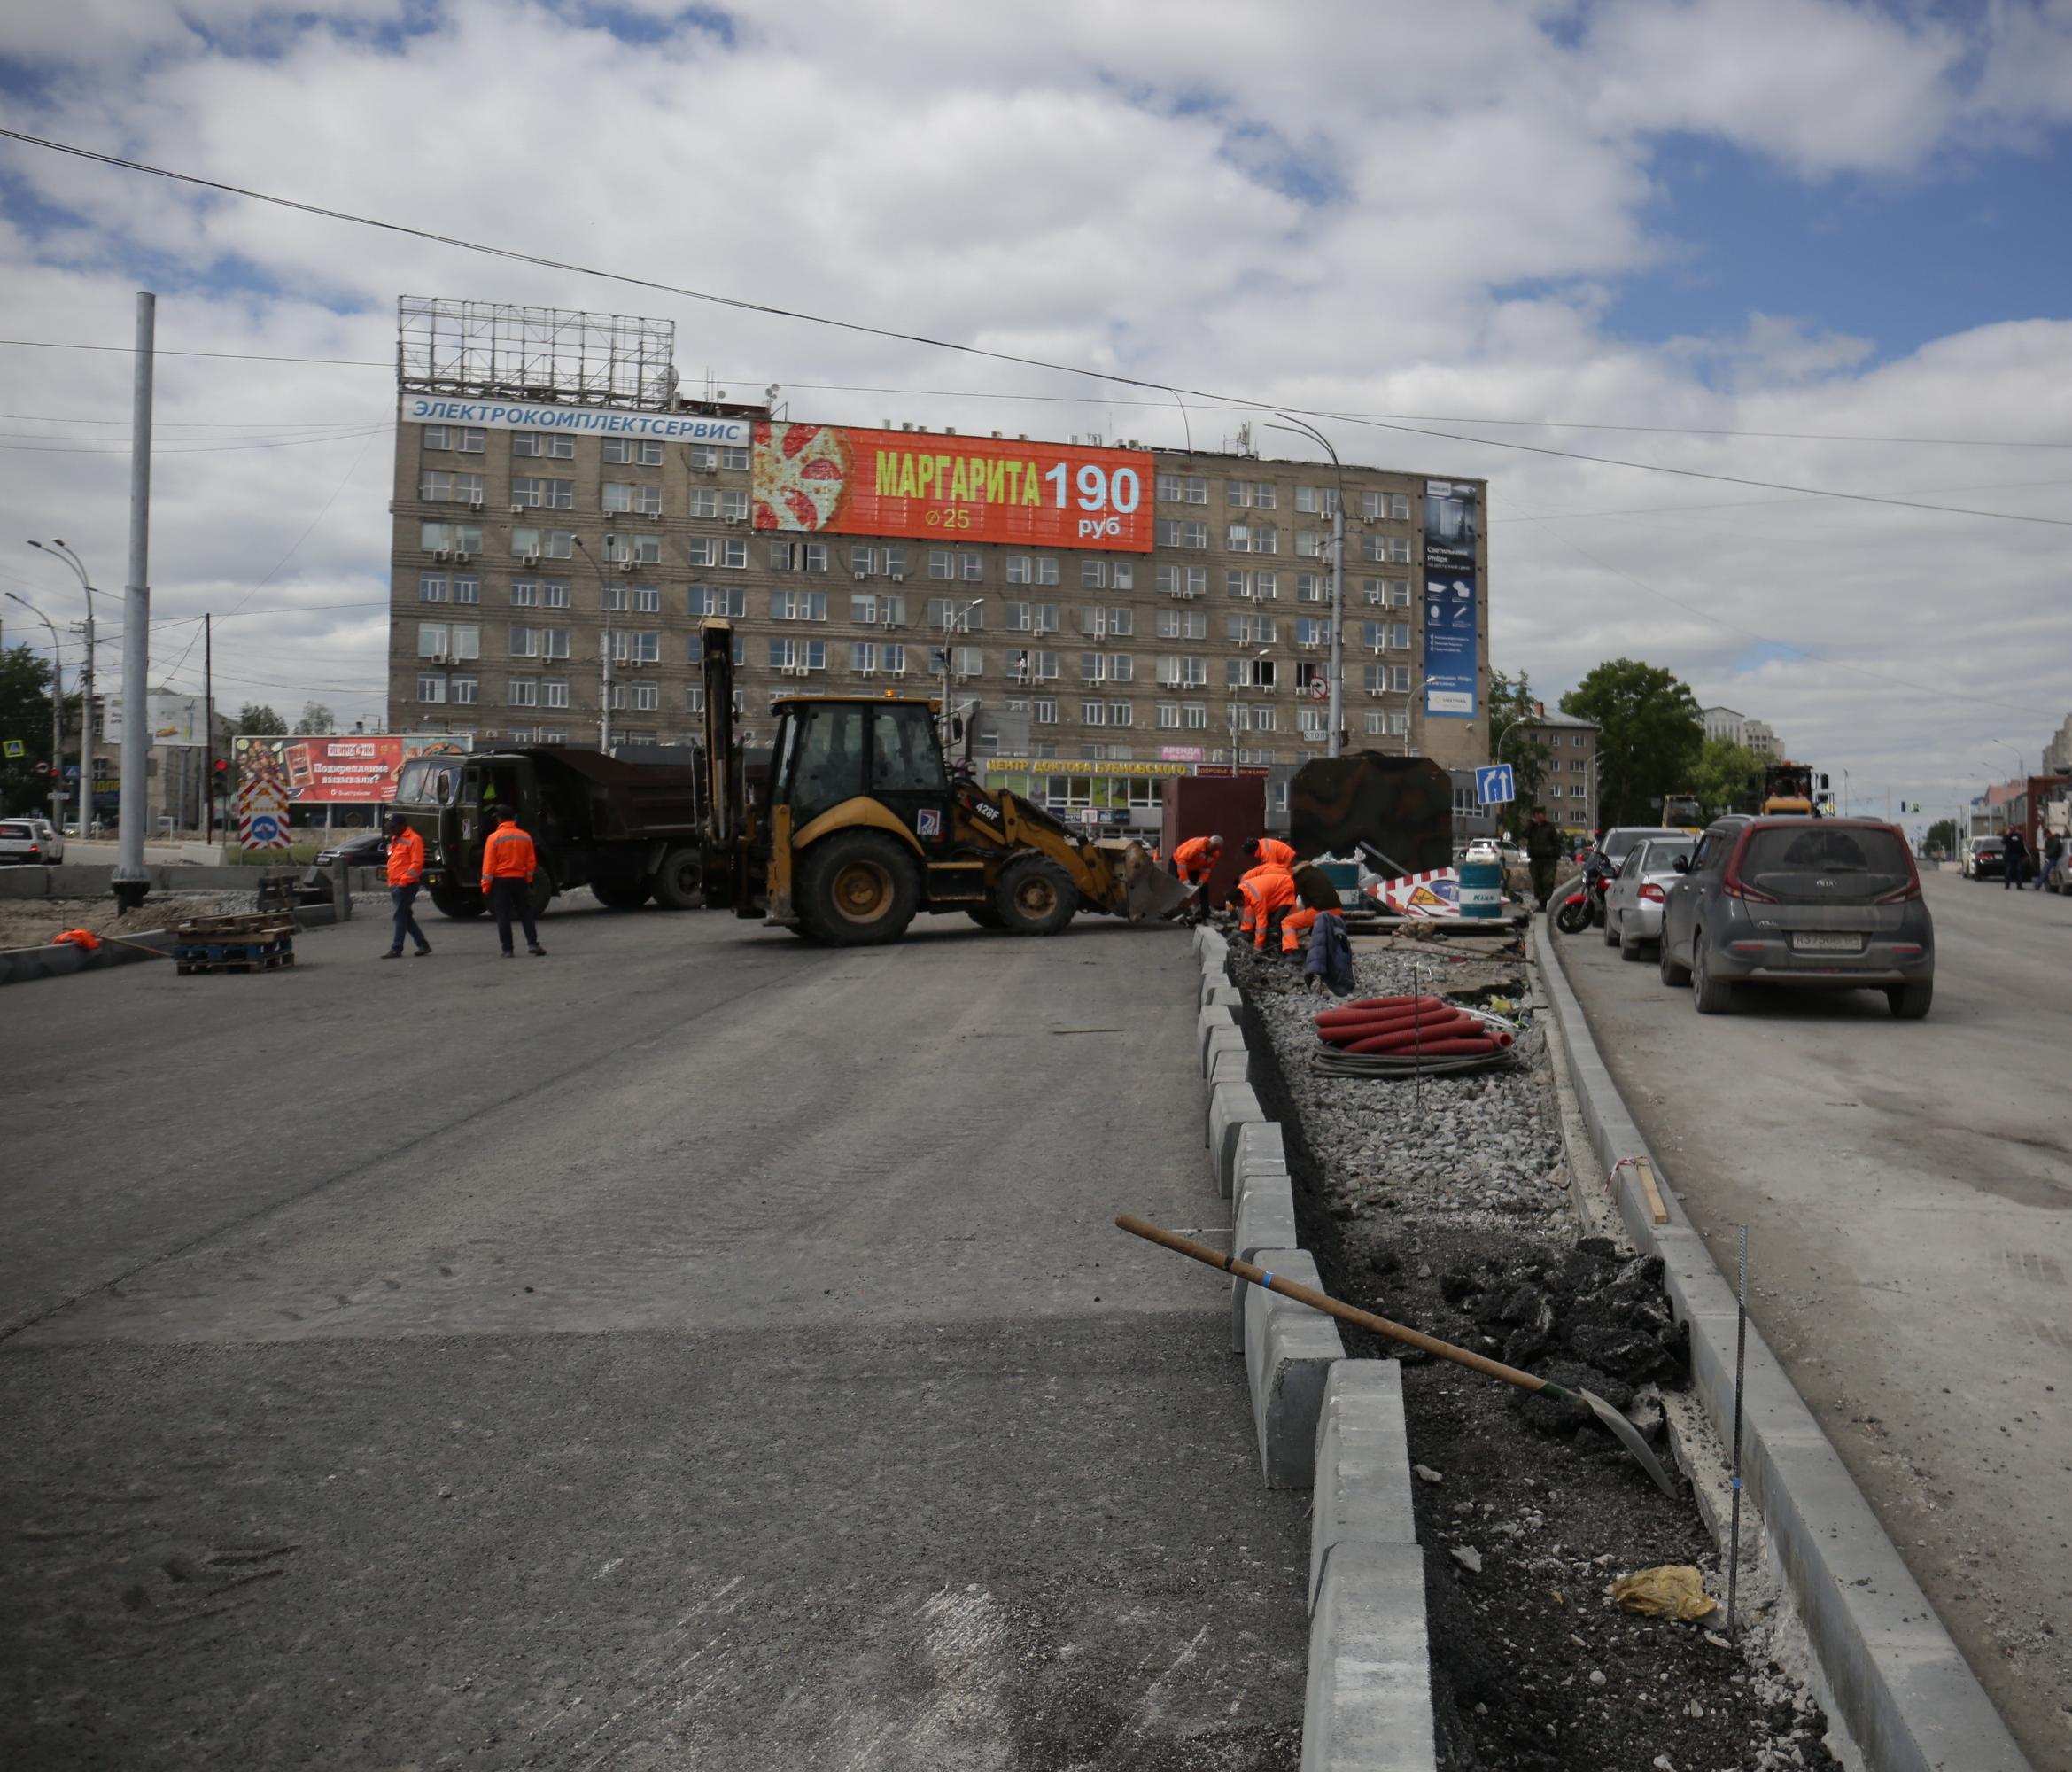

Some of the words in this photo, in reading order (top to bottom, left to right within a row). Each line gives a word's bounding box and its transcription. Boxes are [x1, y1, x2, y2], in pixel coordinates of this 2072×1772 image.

[412, 400, 741, 441] ЭЛЕКТРОКОМПЛЕКТСЕРВИС
[875, 450, 1042, 507] МАРГАРИТА
[1045, 462, 1141, 514] 190
[1078, 516, 1121, 538] руб
[986, 758, 1029, 773] ЦЕНТР
[1033, 760, 1092, 773] ДОКТОРА
[1095, 761, 1187, 775] БУБНОВСКОГО
[975, 802, 1000, 820] 428F
